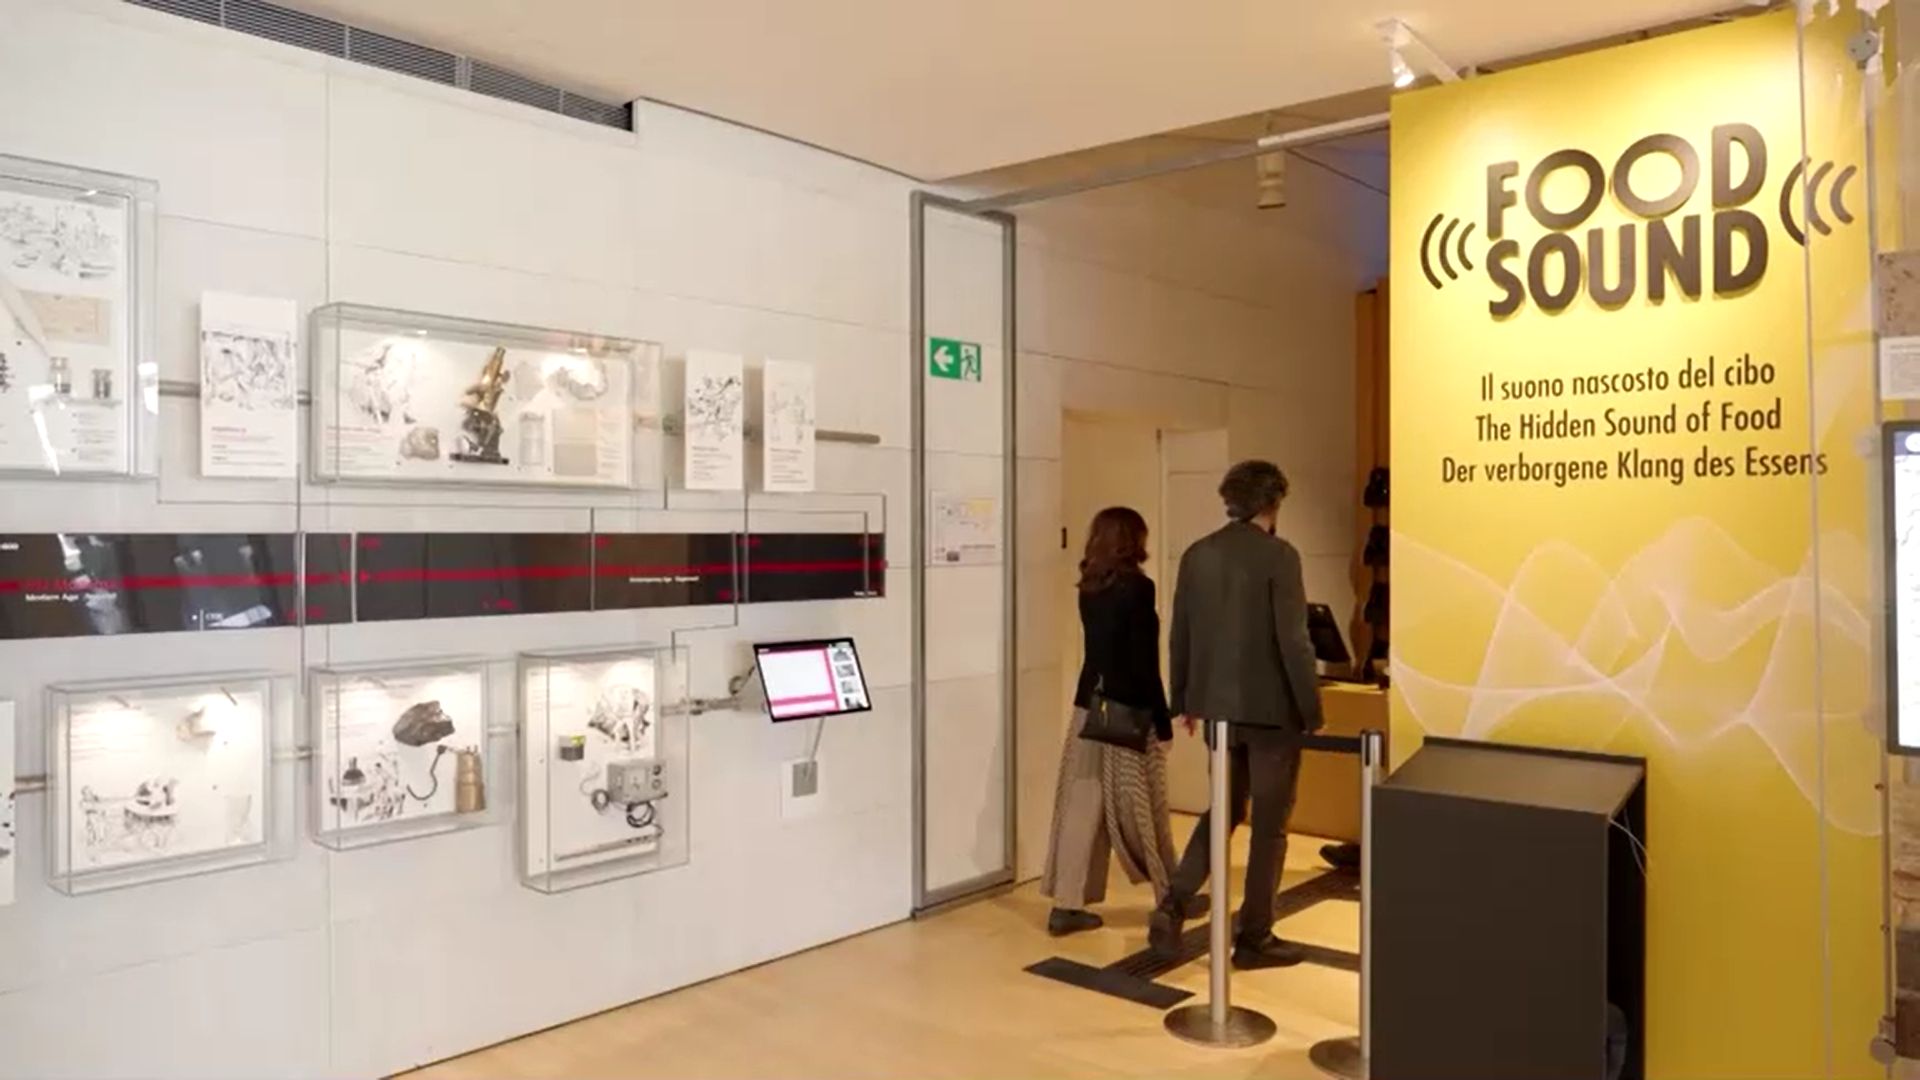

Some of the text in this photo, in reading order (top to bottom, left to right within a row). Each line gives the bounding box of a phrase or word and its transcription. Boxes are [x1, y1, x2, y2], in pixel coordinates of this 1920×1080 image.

[1486, 122, 1768, 240] FOOD
[1485, 209, 1769, 319] SOUND
[1481, 353, 1775, 402] Il suono nascosto del cibo
[1476, 397, 1782, 442] The Hidden Sound of Food
[1442, 445, 1829, 488] Der verborgene Klang des Essens
